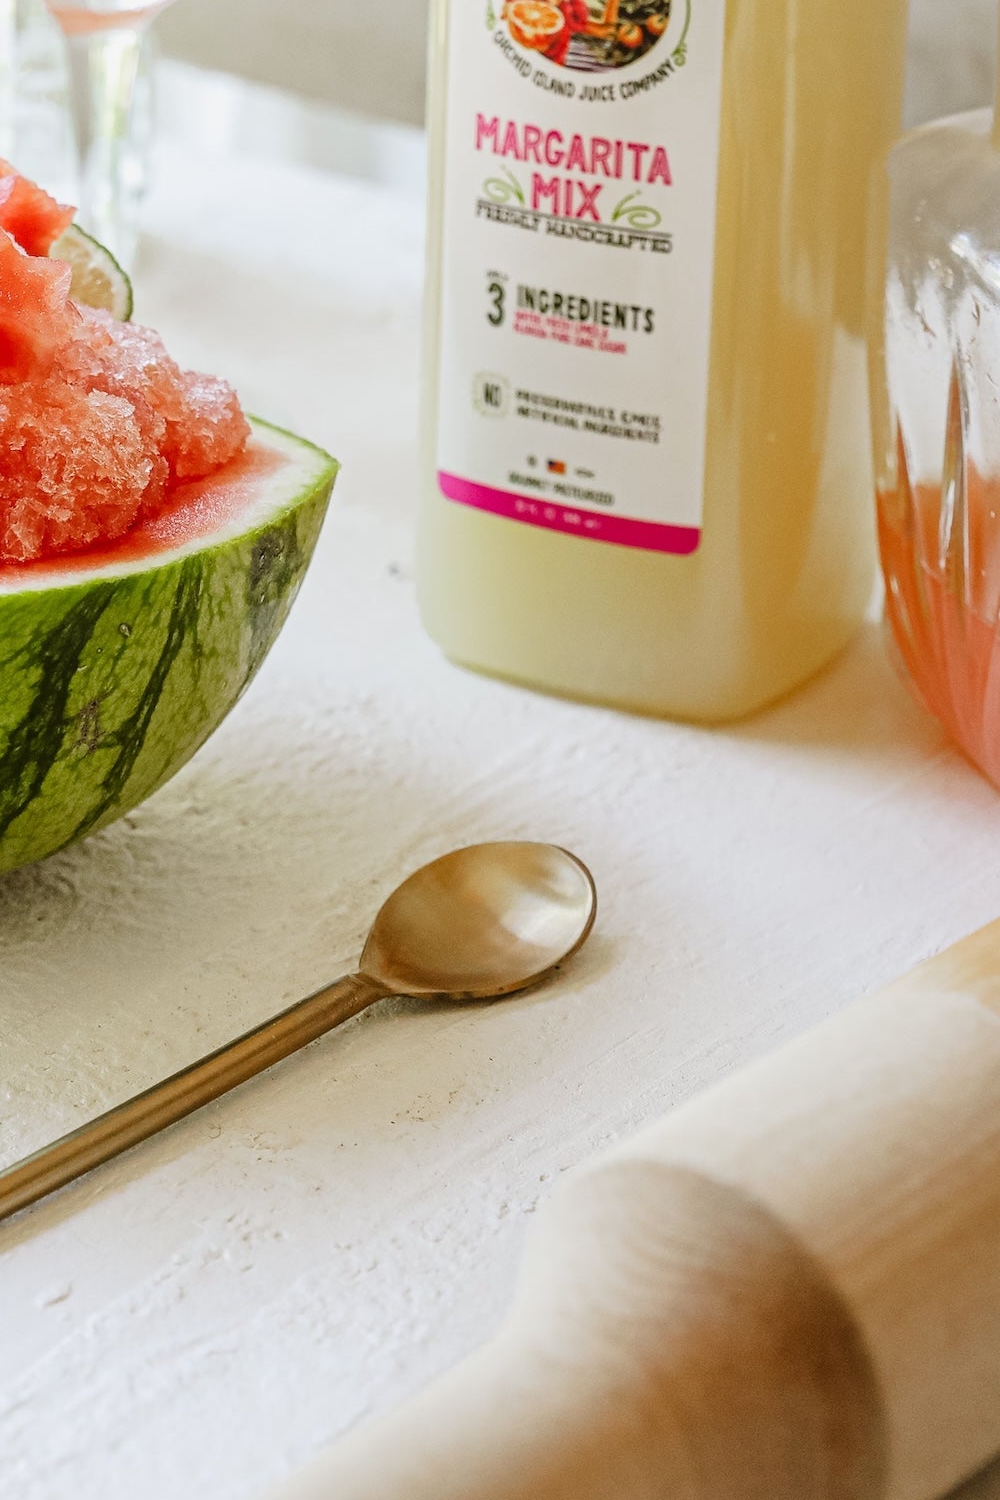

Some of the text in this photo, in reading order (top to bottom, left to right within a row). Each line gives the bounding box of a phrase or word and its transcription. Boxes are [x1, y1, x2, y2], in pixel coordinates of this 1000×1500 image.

[532, 69, 576, 98] ISLAND
[579, 83, 617, 103] JUICE
[618, 58, 676, 100] COMPANY
[475, 113, 672, 186] MARGARITA
[531, 172, 603, 222] MIX
[486, 282, 505, 327] 3
[516, 284, 655, 334] INGREDIENTS
